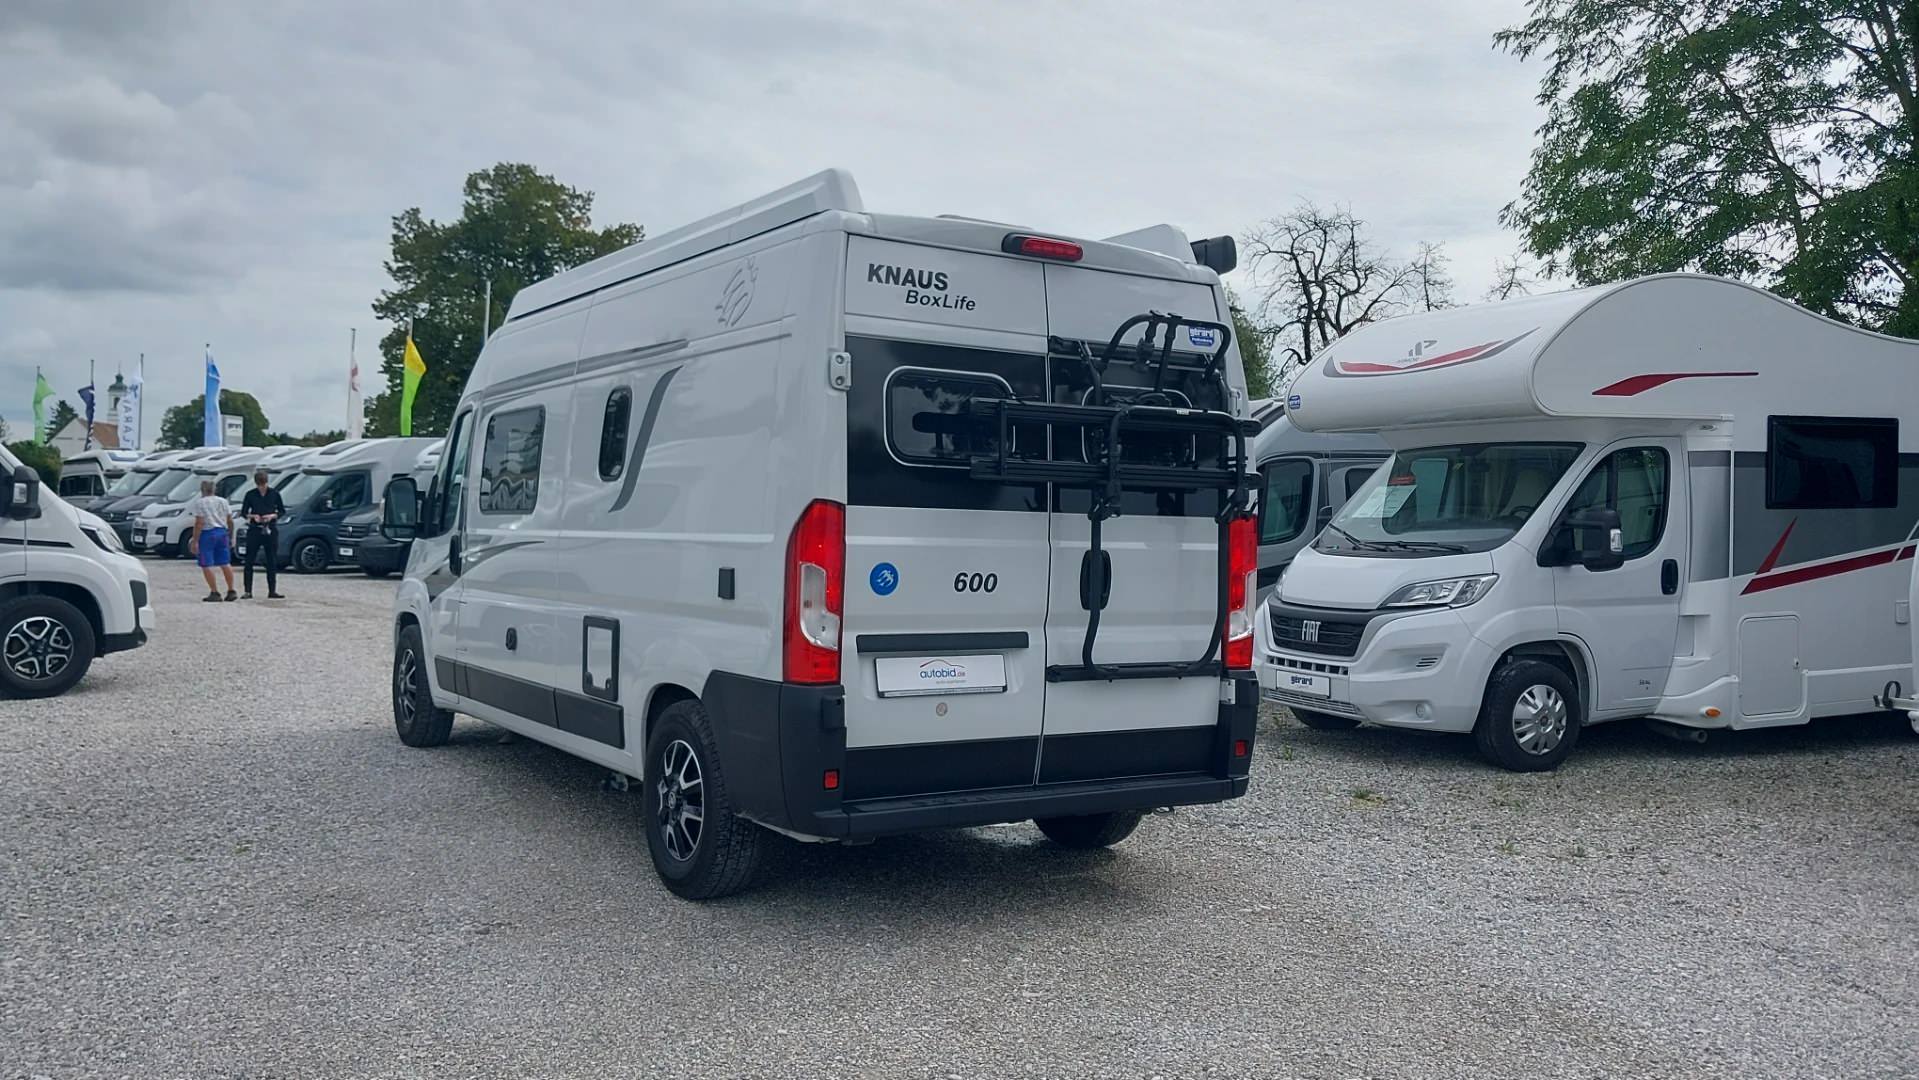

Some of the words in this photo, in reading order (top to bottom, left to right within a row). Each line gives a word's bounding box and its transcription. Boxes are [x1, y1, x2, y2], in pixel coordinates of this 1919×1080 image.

[867, 263, 948, 291] KNAUS
[905, 289, 976, 311] BoxLife
[953, 572, 998, 593] 600
[1301, 620, 1321, 642] FIAT
